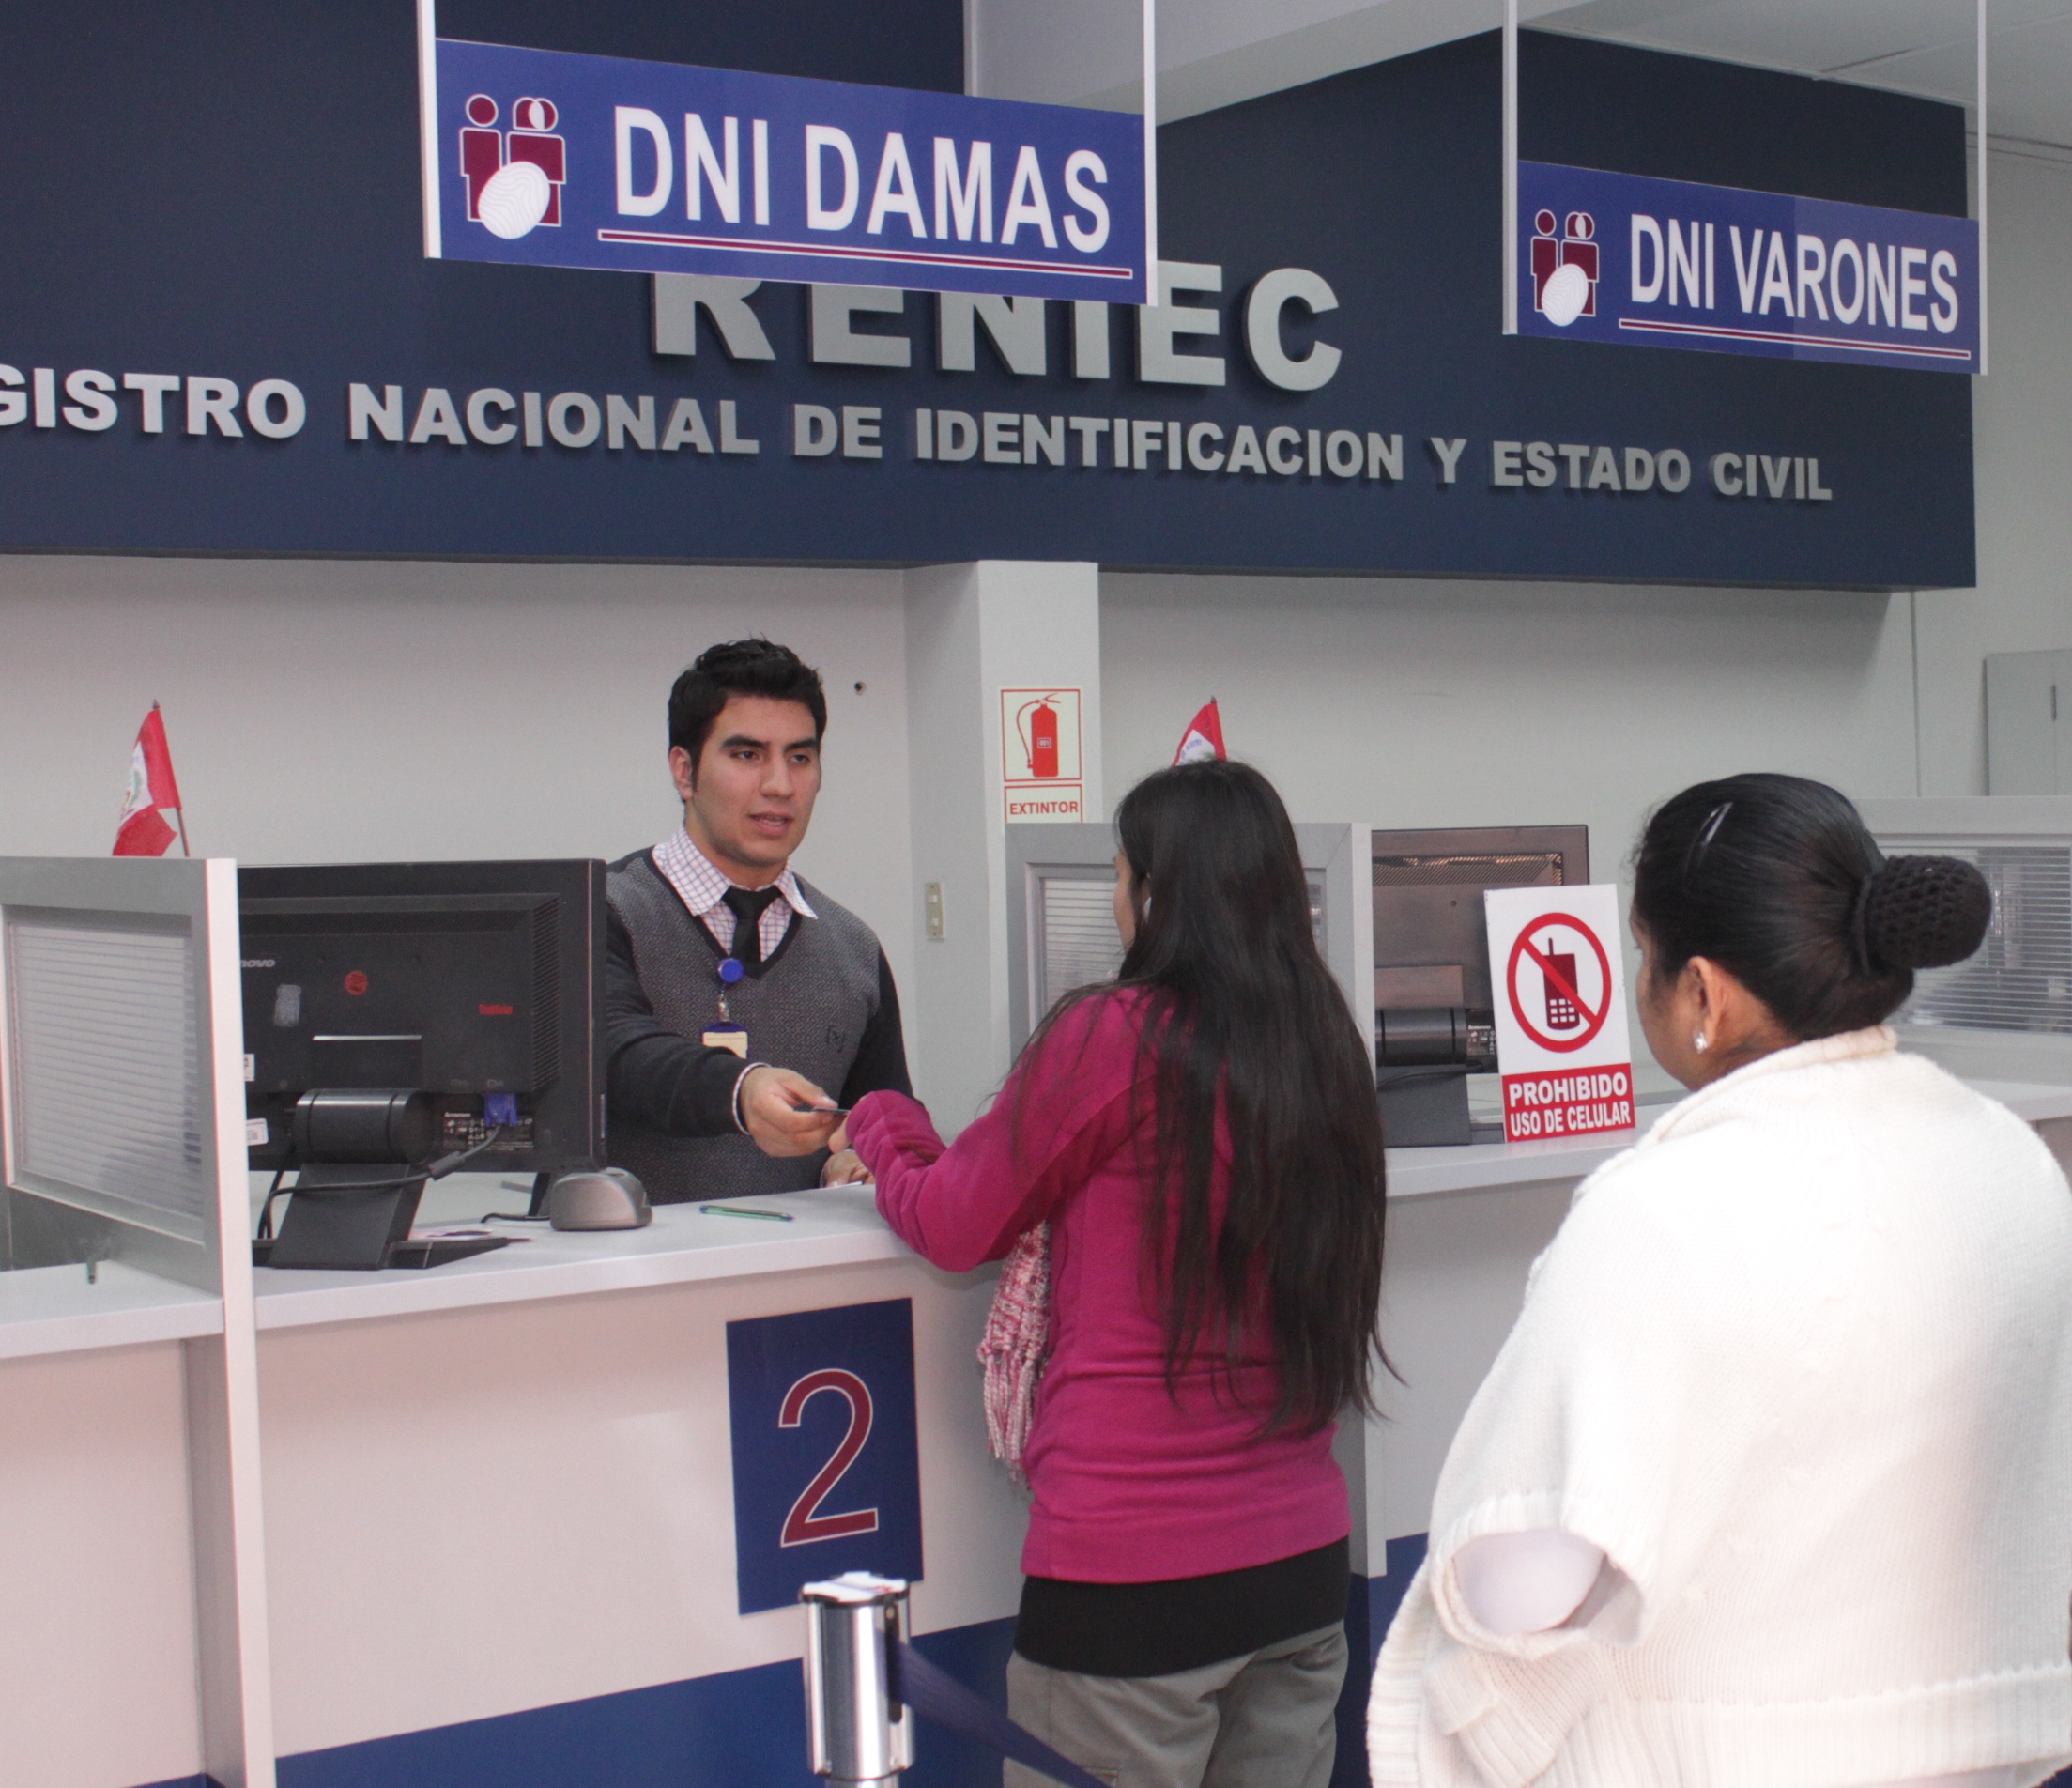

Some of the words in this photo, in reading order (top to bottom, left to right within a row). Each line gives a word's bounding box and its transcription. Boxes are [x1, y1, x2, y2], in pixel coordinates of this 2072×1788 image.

[614, 105, 770, 226] DNI
[805, 124, 1111, 254] DAMAS
[652, 260, 1343, 391] RENIEC
[1630, 213, 1715, 310] DNI
[1728, 224, 1959, 334] VARONES
[349, 382, 760, 455] NACIONAL
[793, 403, 883, 459] DE
[915, 408, 1404, 480] IDENTIFICACION
[1430, 437, 1467, 483] Y
[1492, 440, 1690, 493] ESTADO
[1711, 452, 1833, 501] CIVIL
[1009, 800, 1079, 815] EXTINTOR
[1509, 1072, 1628, 1108] PROHIBIDO
[1510, 1110, 1542, 1137] USO
[1543, 1107, 1565, 1133] DE
[1567, 1101, 1631, 1131] CELULAR
[777, 1367, 879, 1548] 2
